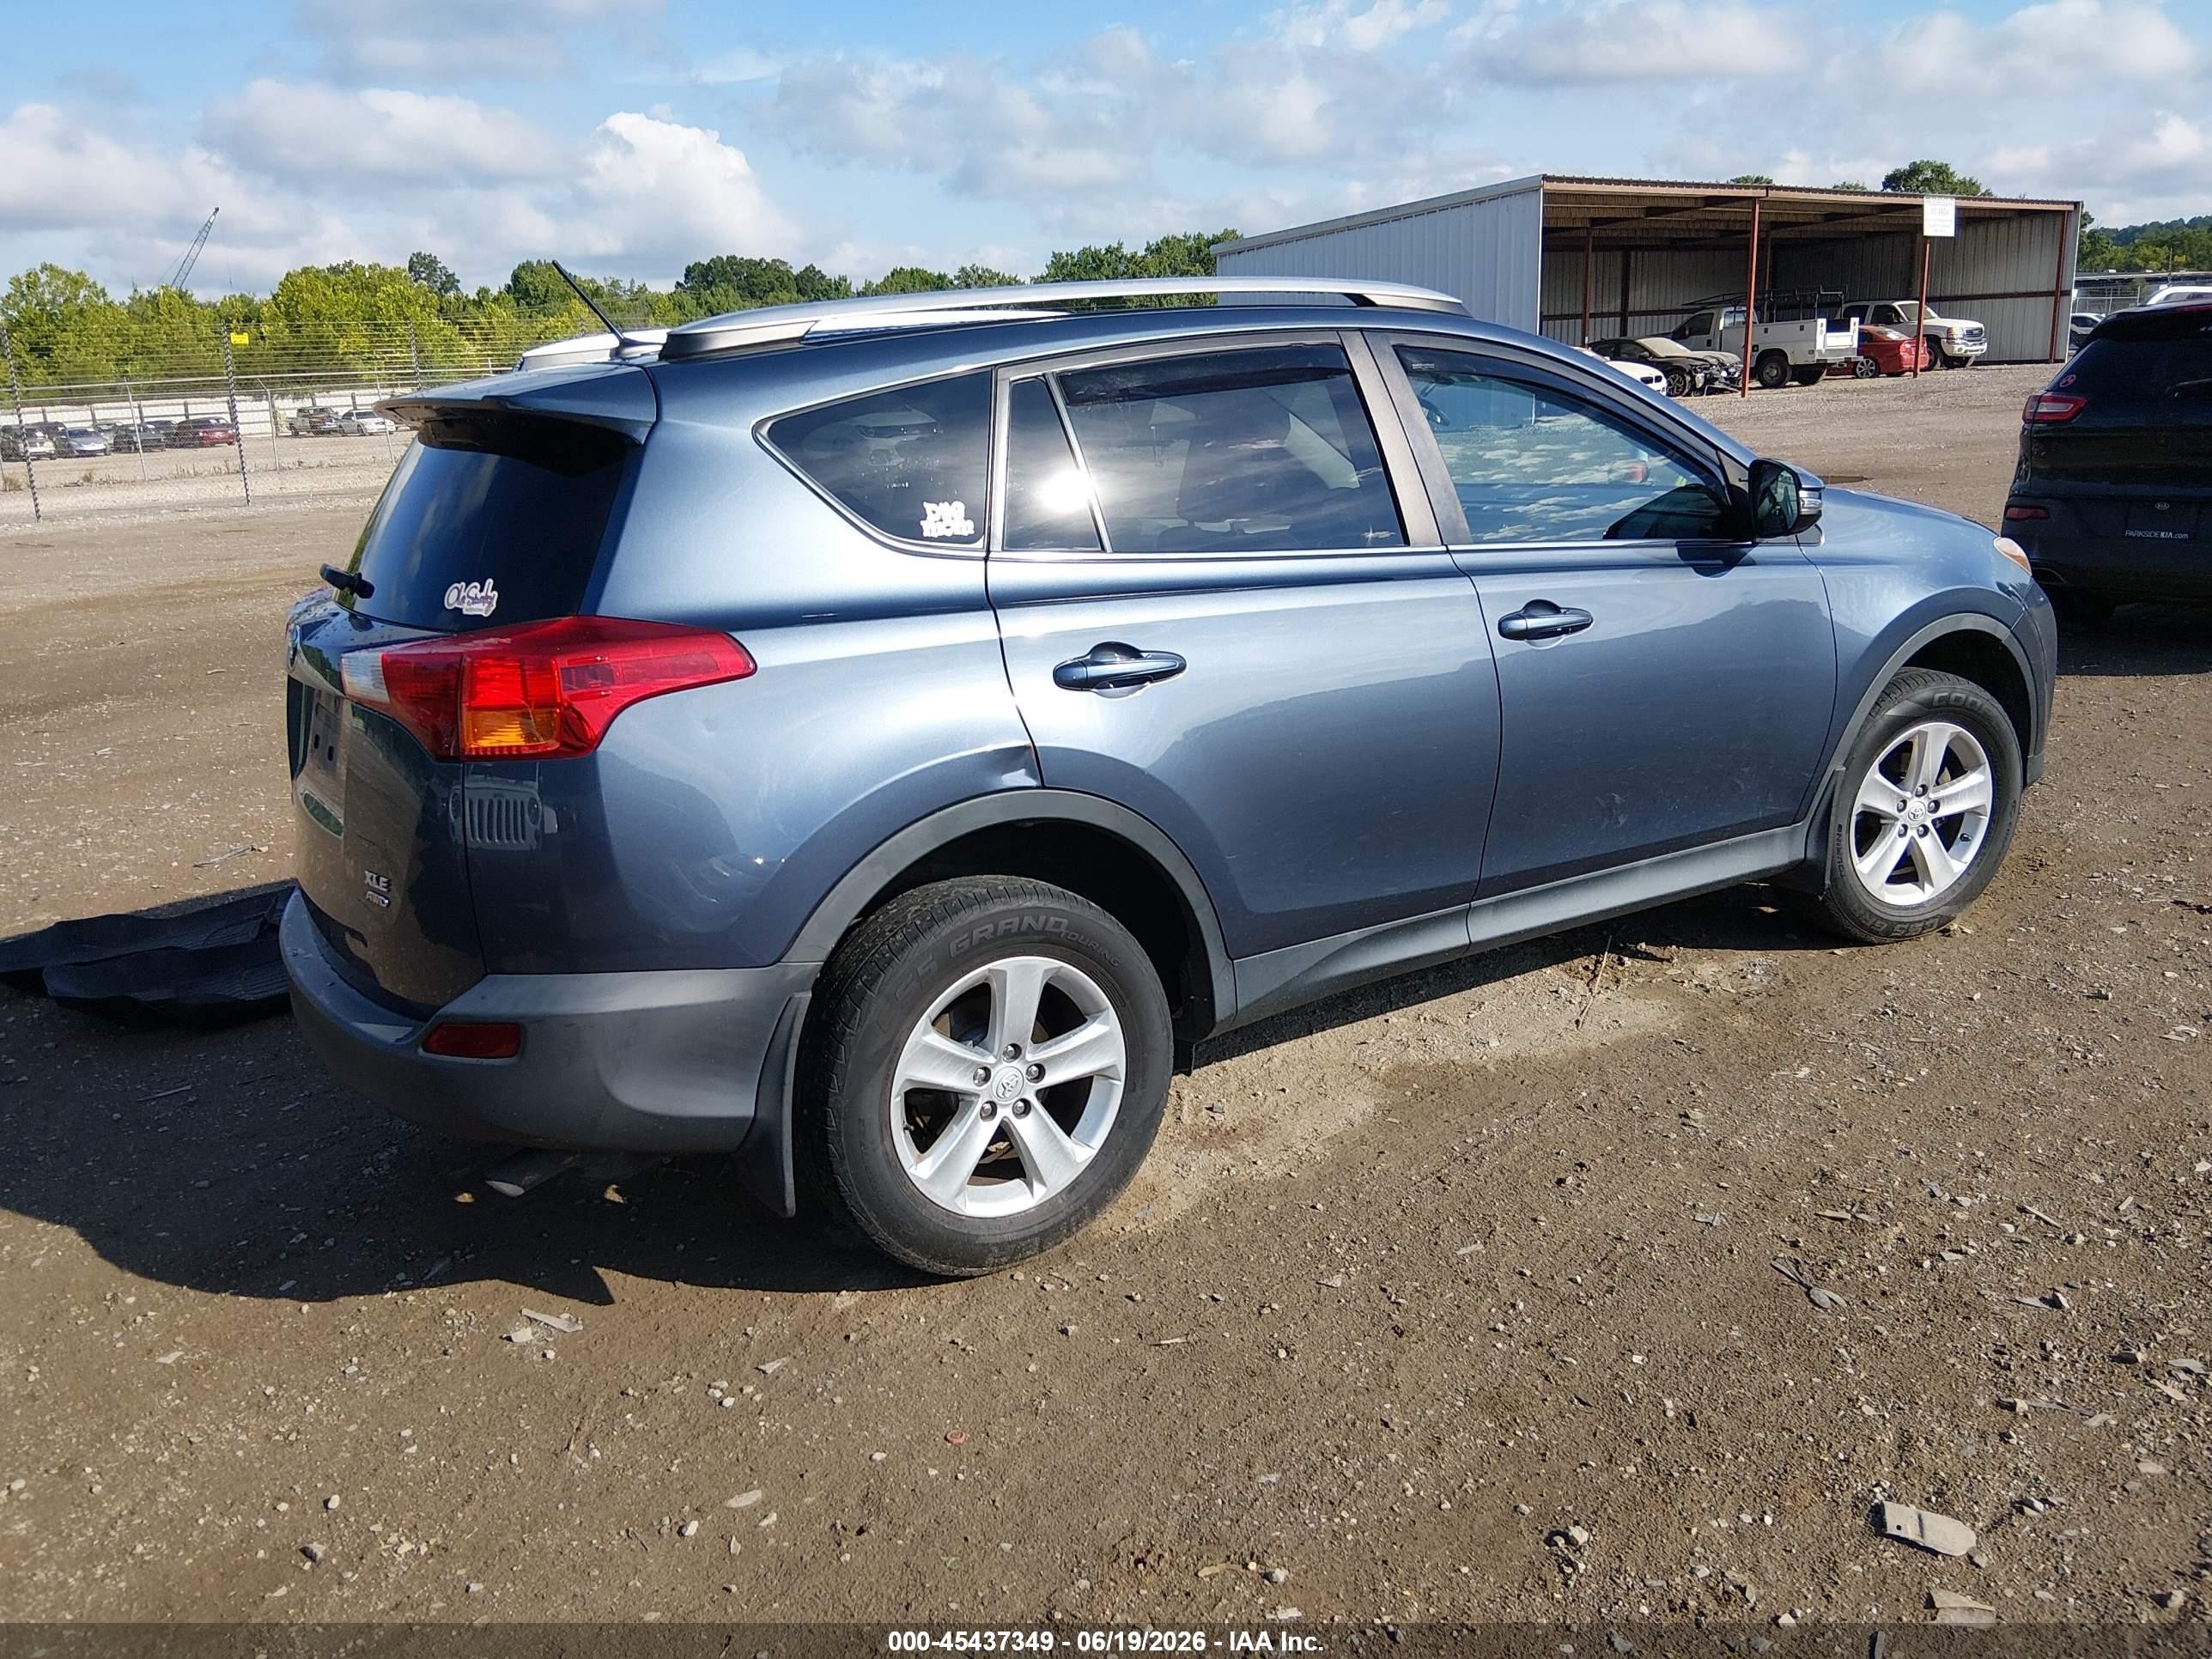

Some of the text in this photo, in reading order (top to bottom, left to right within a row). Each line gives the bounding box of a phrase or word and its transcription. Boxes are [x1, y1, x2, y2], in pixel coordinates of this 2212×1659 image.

[364, 870, 390, 892] XLE
[948, 915, 1069, 957] GRAND
[1059, 929, 1121, 968] TOURING
